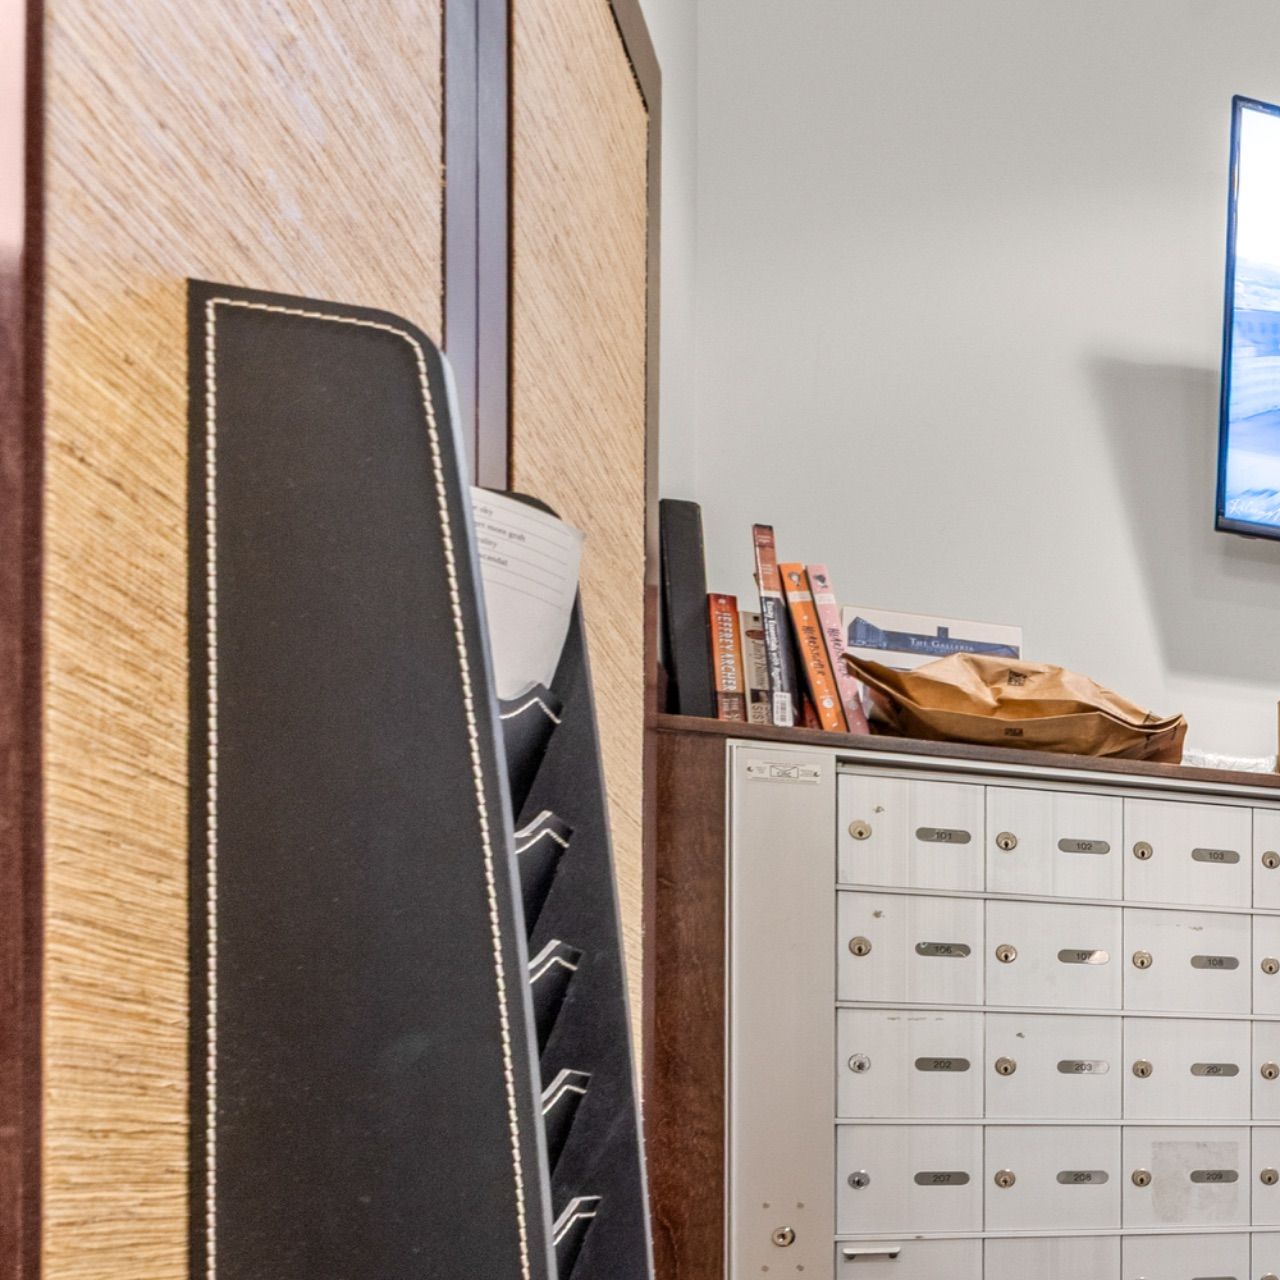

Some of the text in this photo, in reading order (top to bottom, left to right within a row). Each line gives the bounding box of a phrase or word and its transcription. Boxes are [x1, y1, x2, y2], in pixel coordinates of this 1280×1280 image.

[716, 611, 735, 650] JEFFREY
[931, 639, 975, 652] GALLERIA
[721, 653, 737, 691] ARCHER
[937, 832, 952, 840] 101
[1076, 843, 1092, 851] 102
[1209, 852, 1224, 860] 103
[1073, 1173, 1091, 1181] 208
[1207, 1172, 1223, 1180] 209
